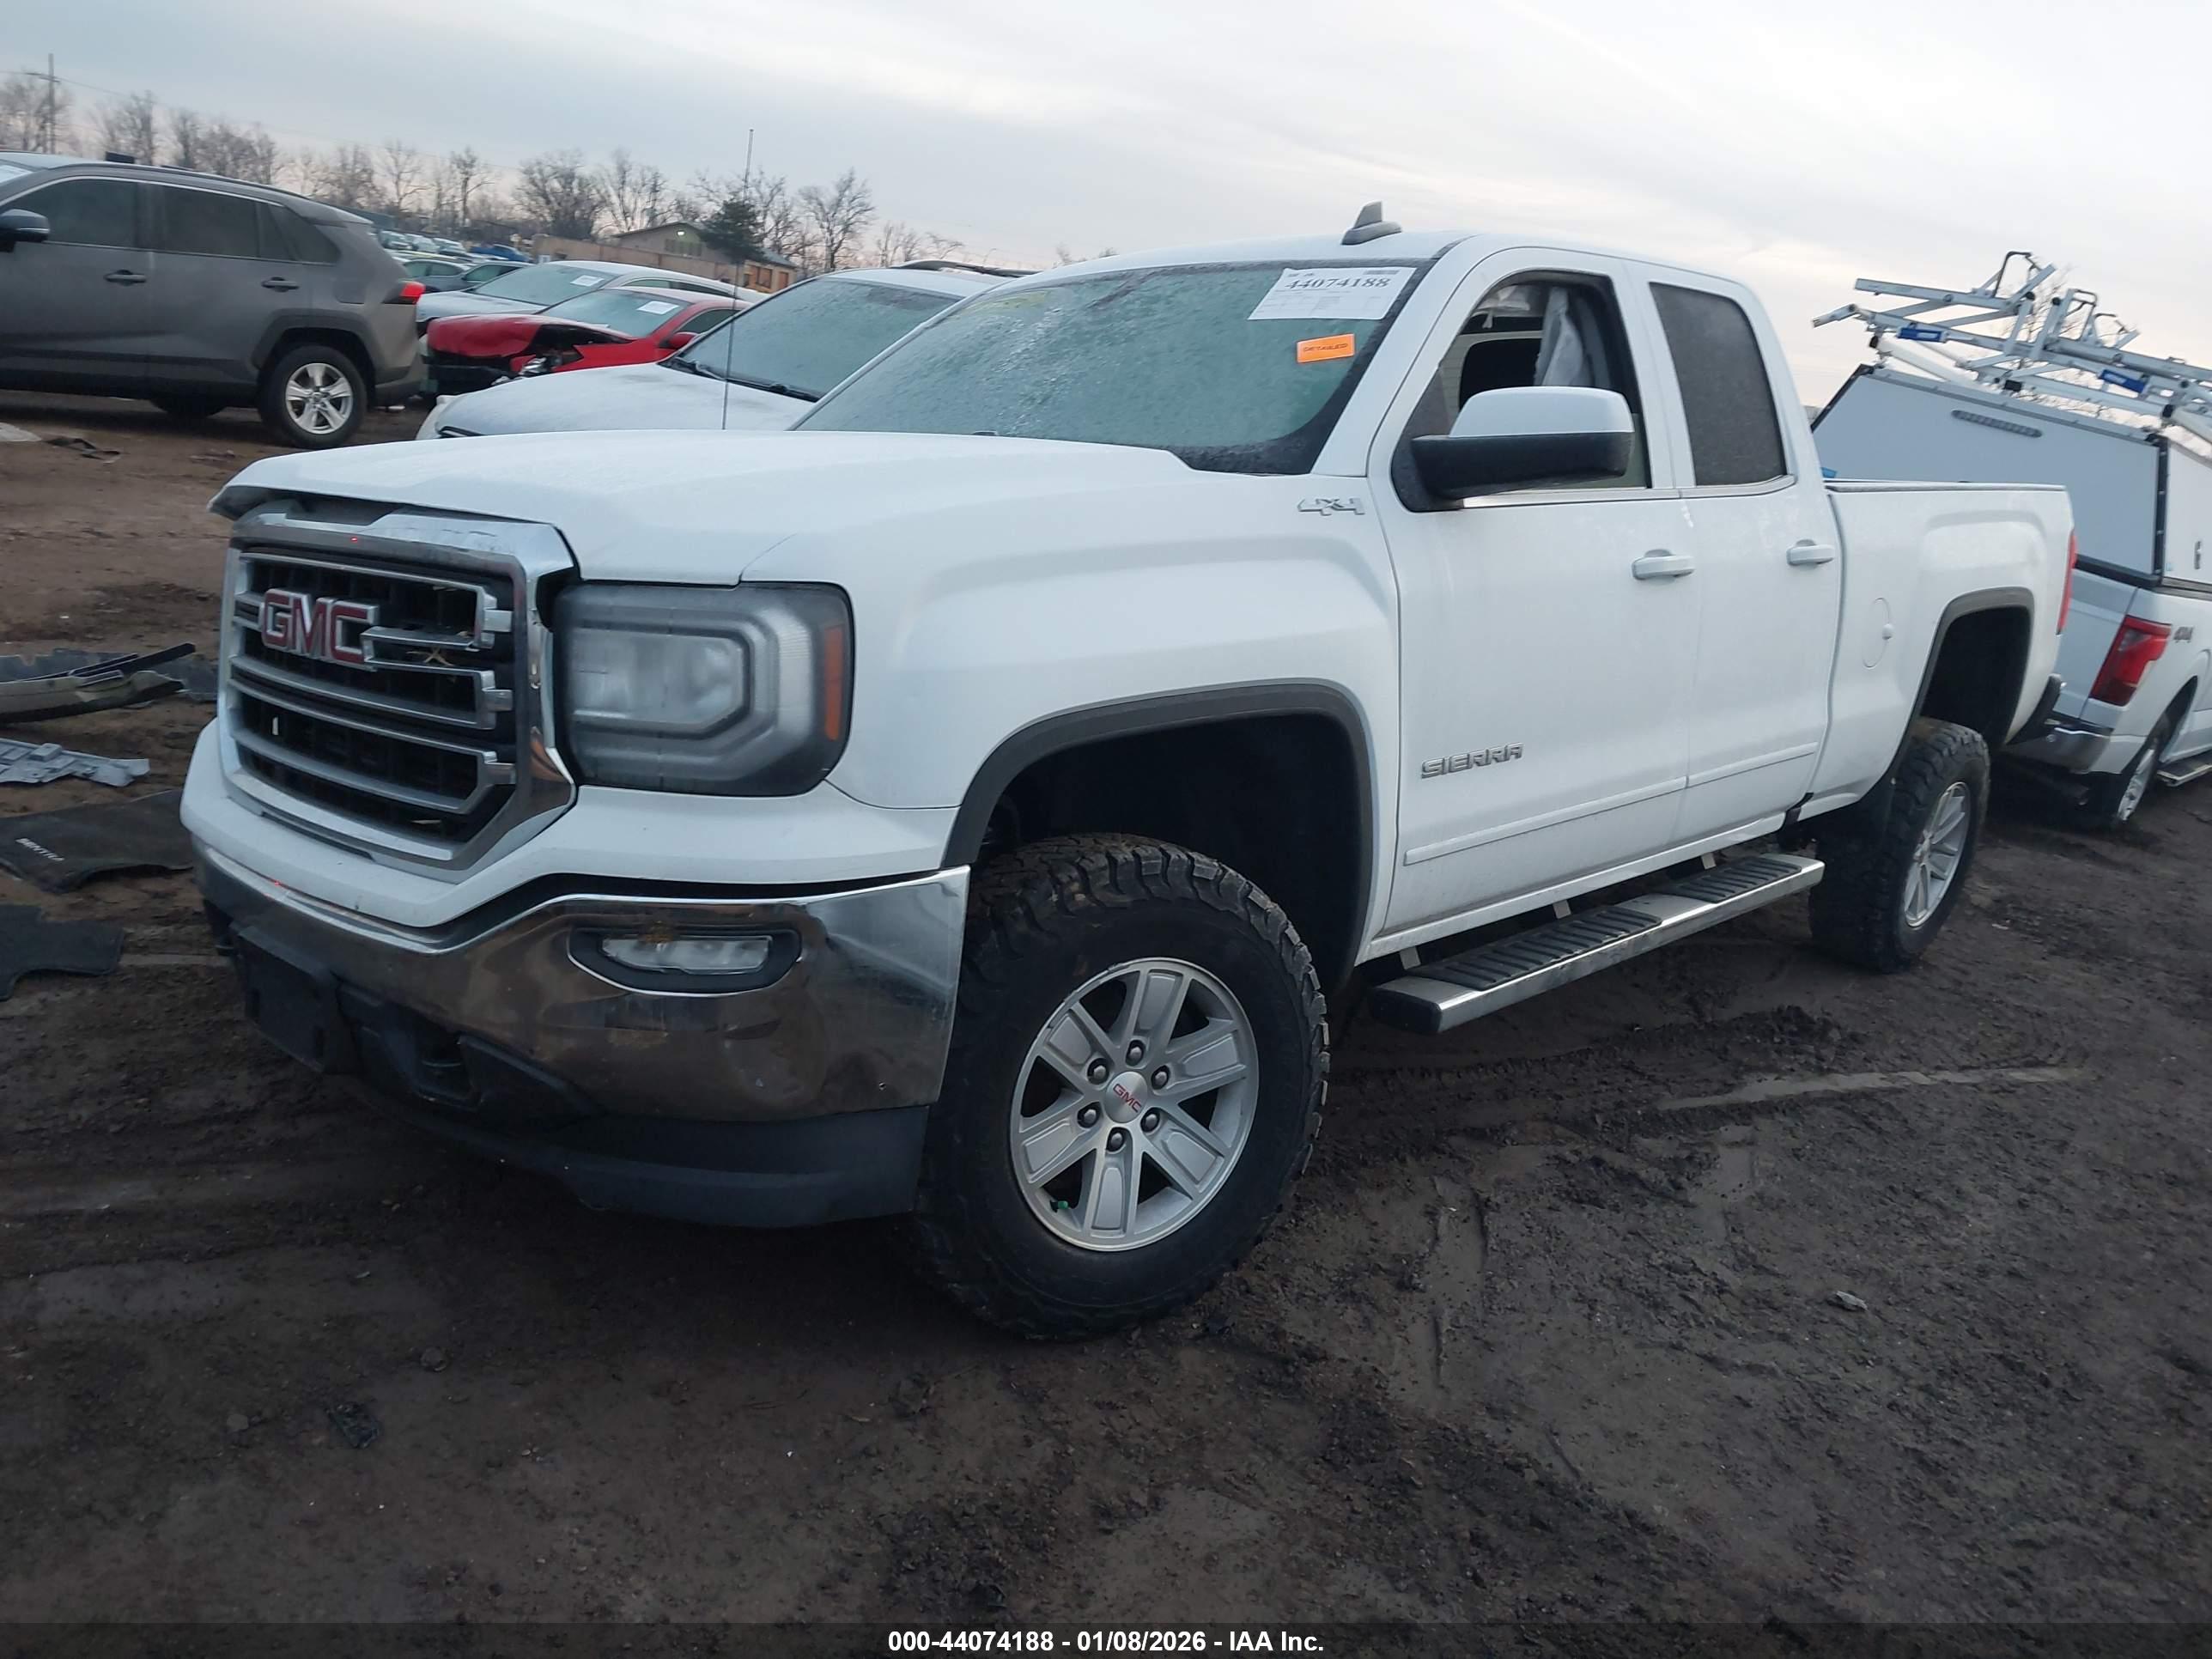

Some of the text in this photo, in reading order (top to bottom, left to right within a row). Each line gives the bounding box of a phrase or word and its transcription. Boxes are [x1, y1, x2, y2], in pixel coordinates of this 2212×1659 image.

[1285, 277, 1390, 289] 44074188
[261, 588, 380, 672] GMC
[1421, 742, 1523, 779] SIERRA
[1113, 1083, 1142, 1113] GMC
